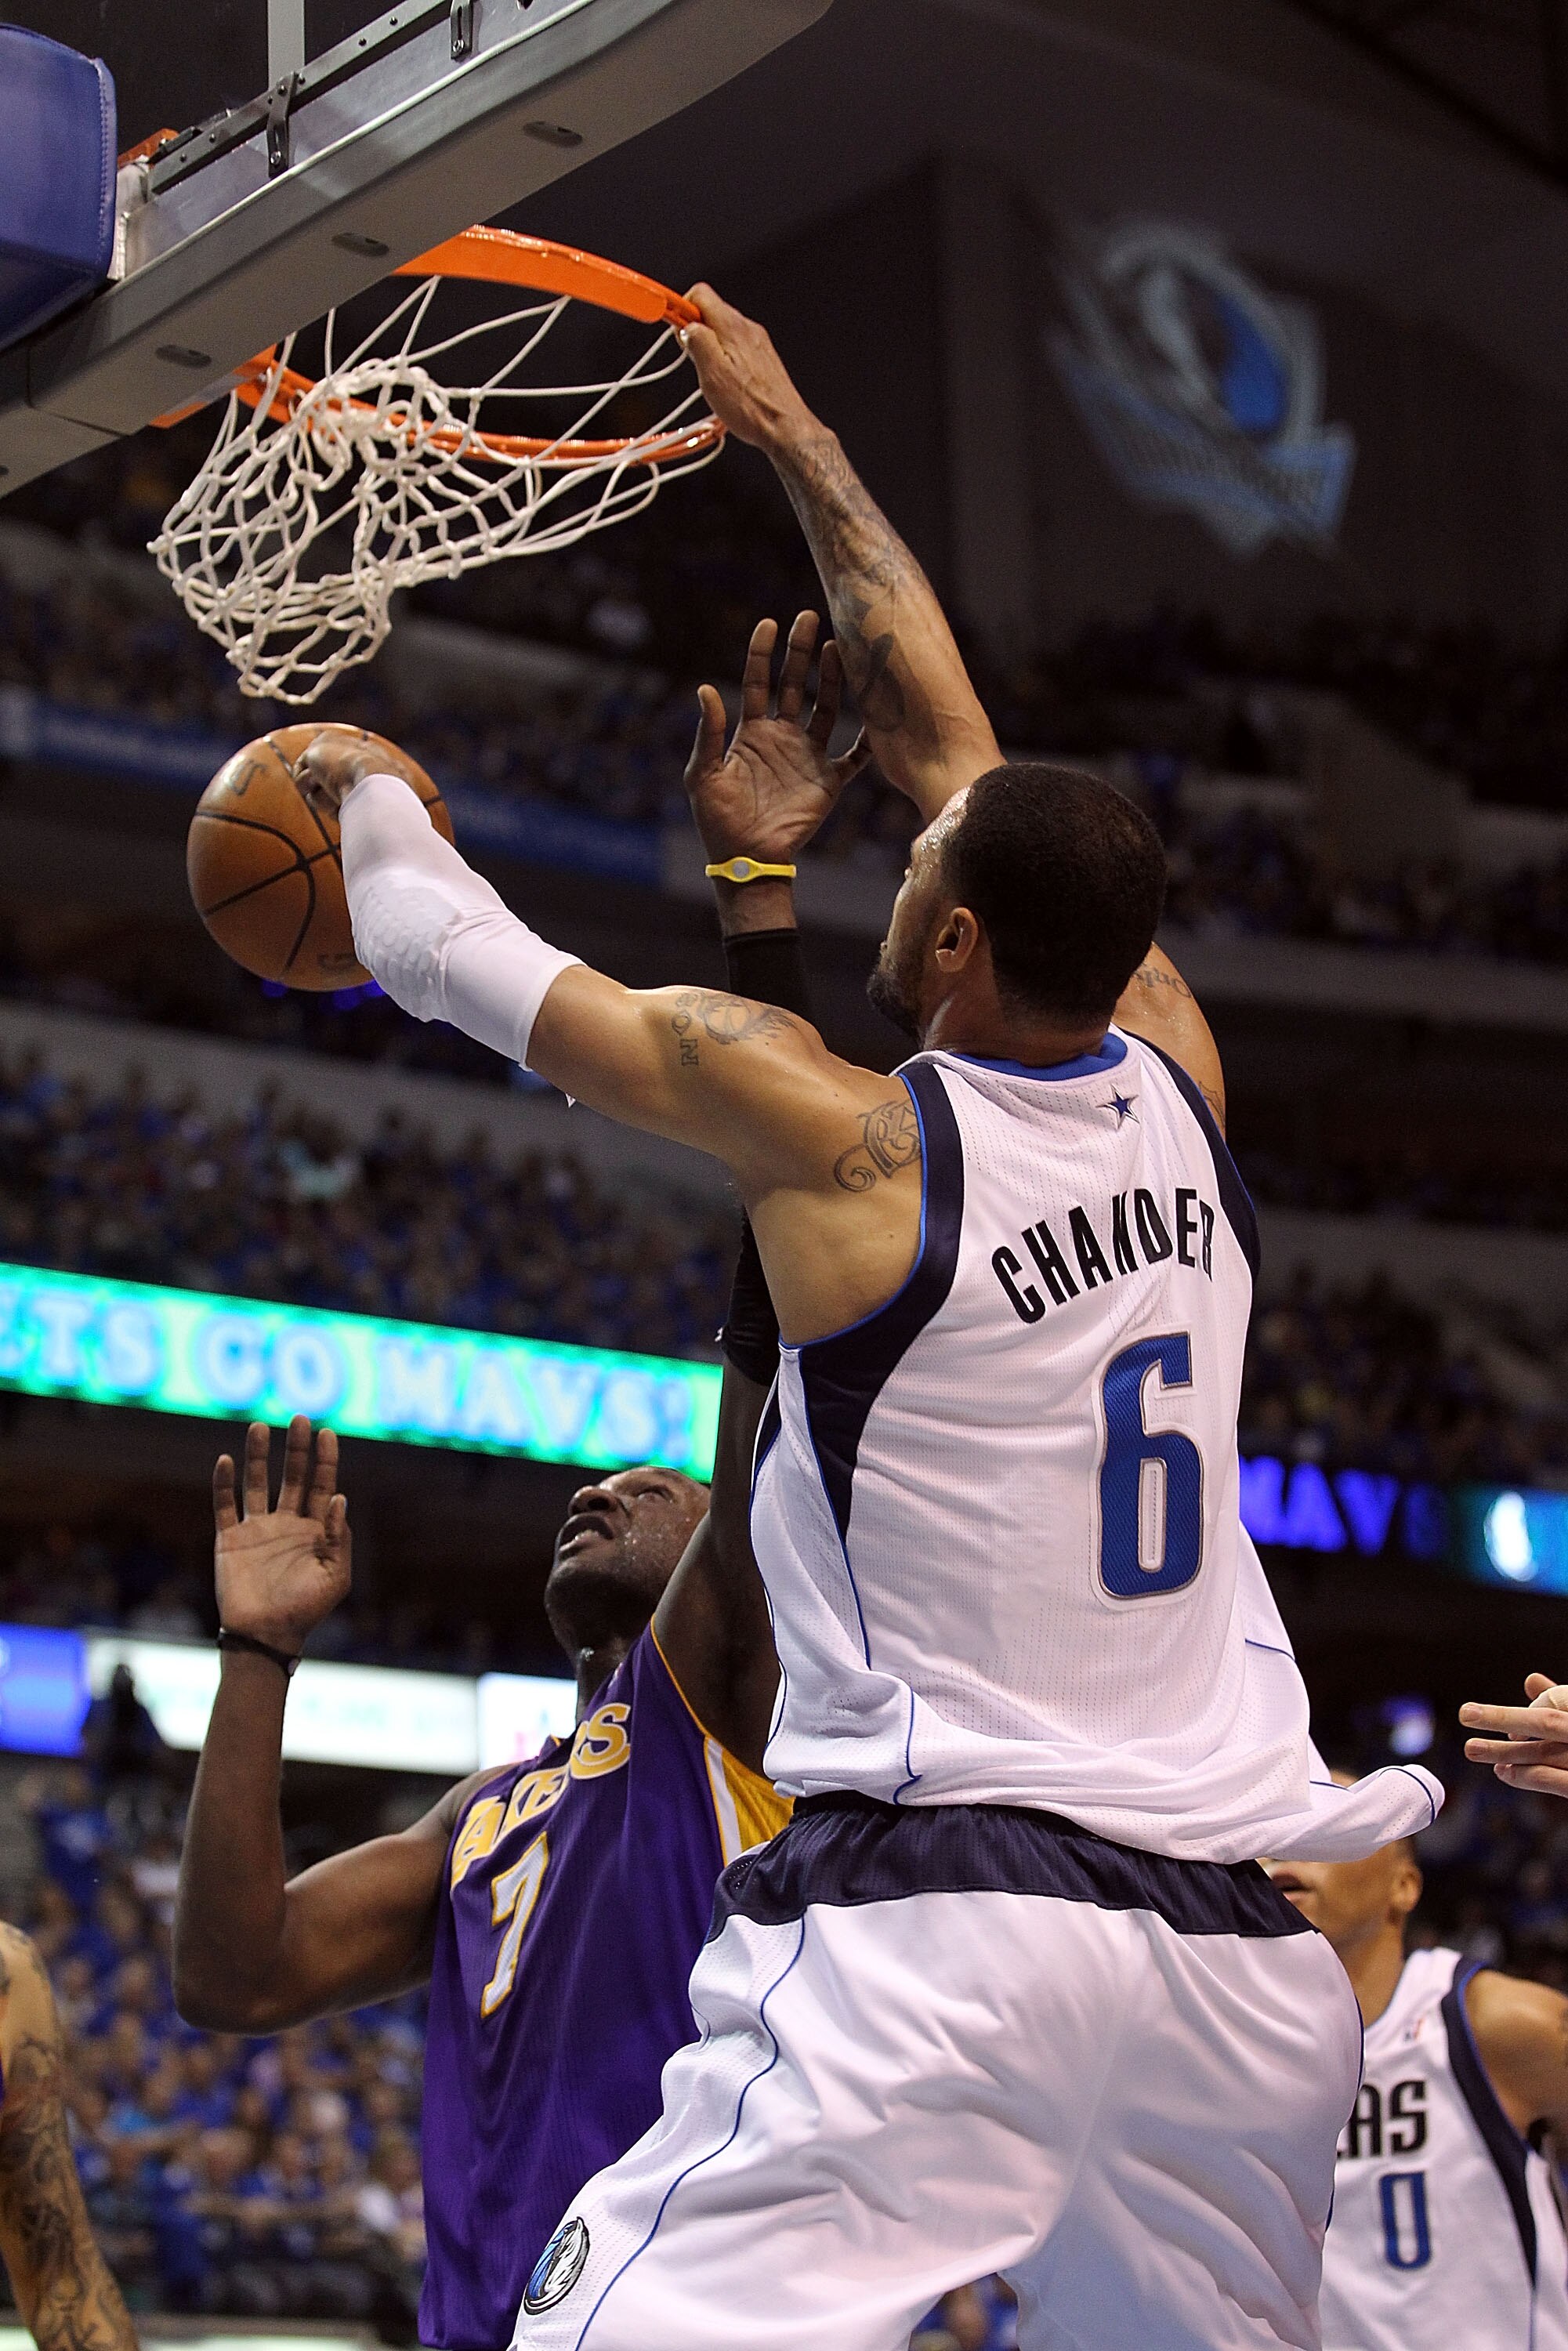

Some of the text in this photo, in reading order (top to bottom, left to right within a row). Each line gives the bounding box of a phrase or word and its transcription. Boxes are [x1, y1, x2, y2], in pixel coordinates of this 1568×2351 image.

[991, 1187, 1215, 1324] CHANDER
[1096, 1328, 1205, 1601] 6
[480, 1830, 549, 2019] 7
[1379, 2171, 1432, 2269] 0
